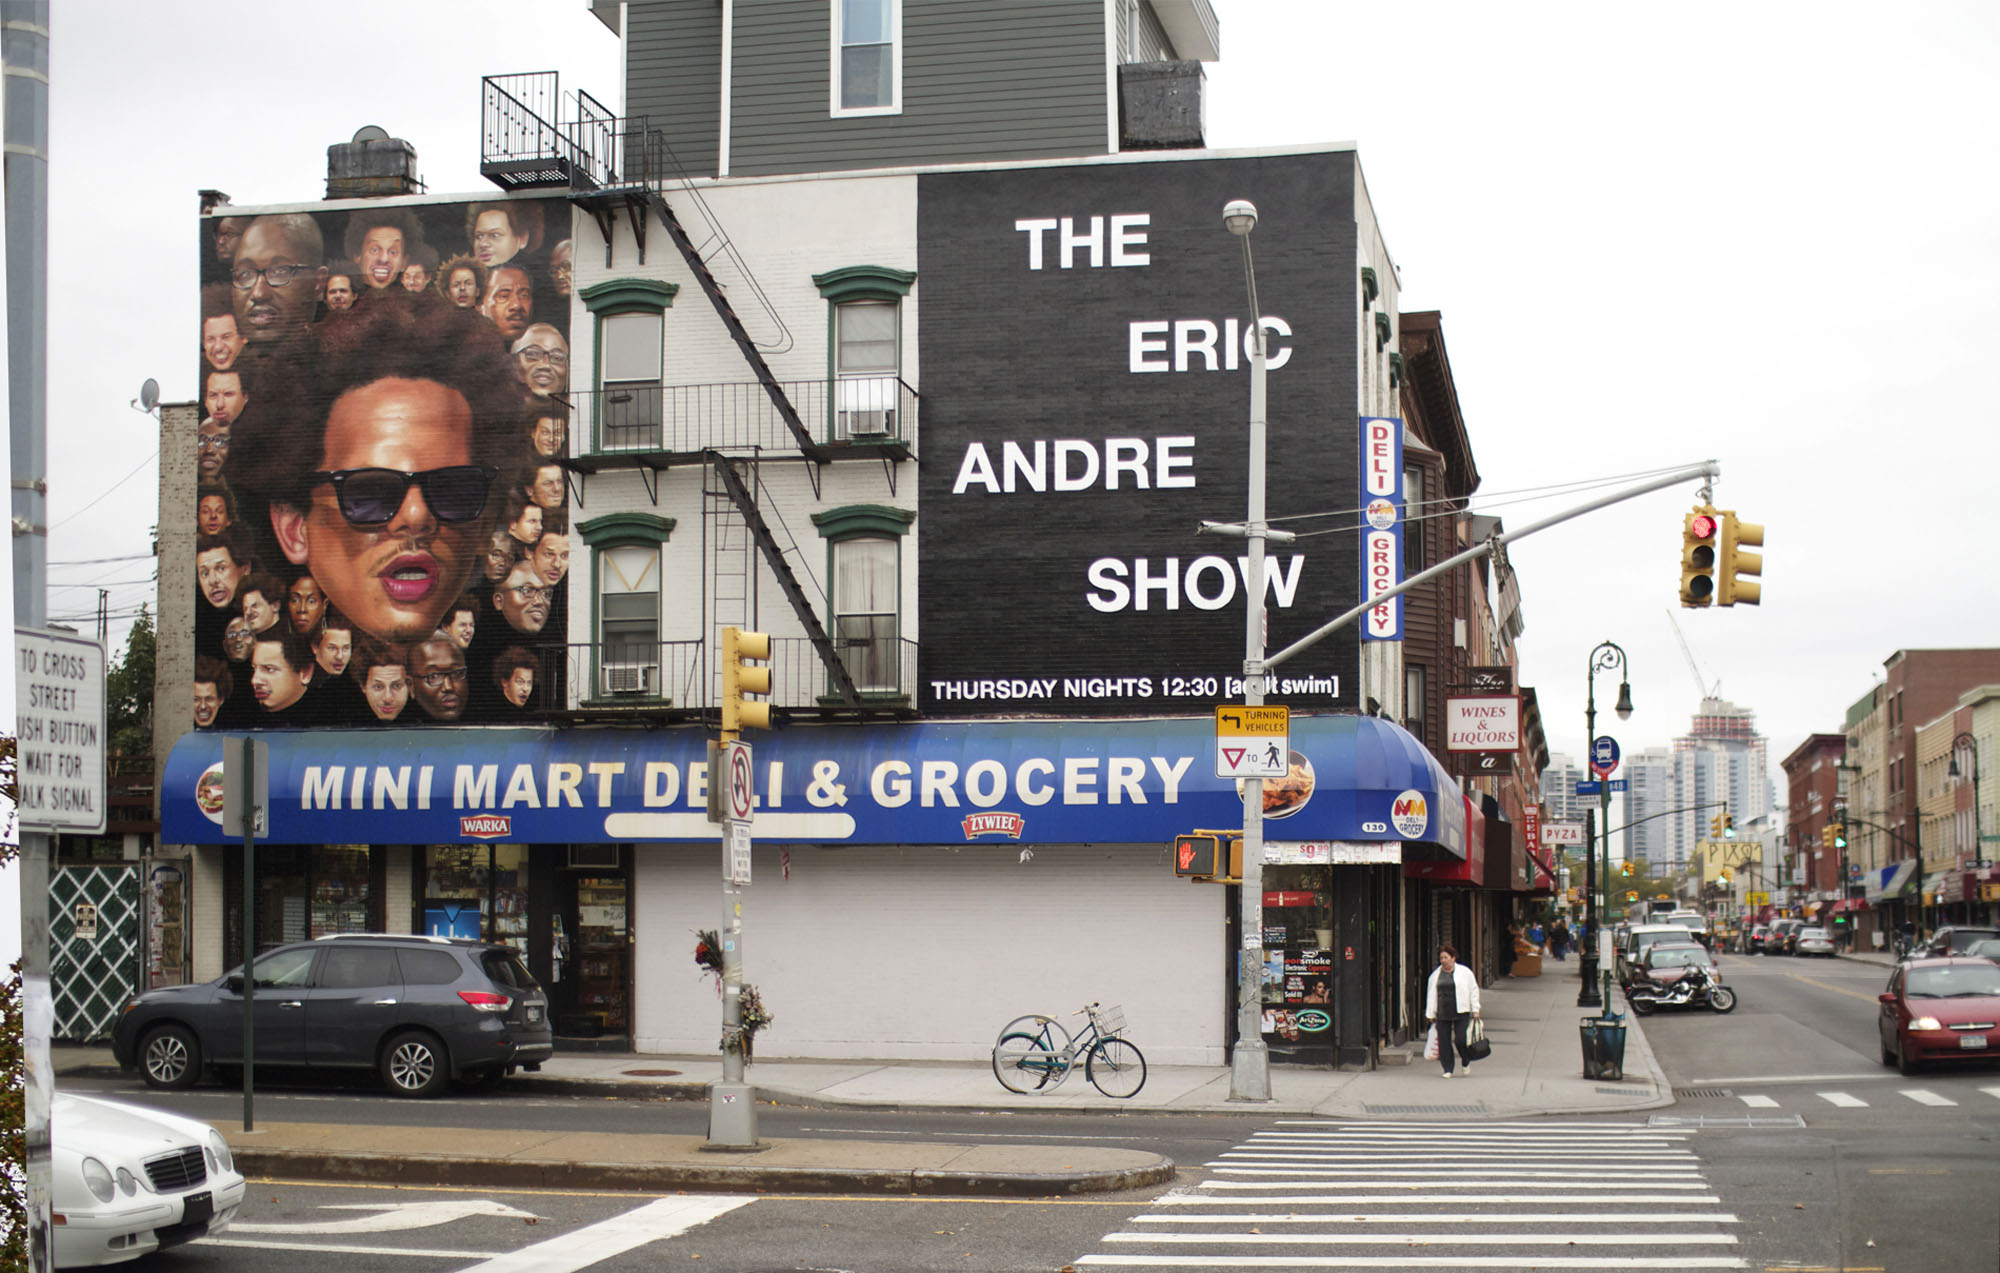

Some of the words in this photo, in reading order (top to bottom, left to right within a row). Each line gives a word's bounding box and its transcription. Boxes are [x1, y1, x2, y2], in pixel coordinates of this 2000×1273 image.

[1015, 213, 1150, 270] THE
[1129, 316, 1292, 373] ERIC
[952, 436, 1196, 494] ANDRE
[1372, 426, 1388, 489] DELI
[1086, 555, 1304, 613] SHOW
[20, 649, 36, 673] TO
[43, 652, 86, 681] CROSS
[30, 683, 76, 712] STREET
[931, 680, 1056, 700] THURSDAY
[1063, 678, 1153, 698] NIGHTS
[1161, 677, 1218, 697] 12:30
[1281, 675, 1340, 698] swim]
[1245, 711, 1285, 720] TURNING
[1461, 707, 1506, 718] WINES
[1477, 720, 1488, 730] &
[16, 716, 43, 741] USH
[50, 719, 97, 746] BUTTON
[1245, 723, 1285, 732] VEHICLES
[1452, 732, 1516, 745] LIQUORS
[25, 752, 52, 776] WAIT
[58, 752, 82, 778] FOR
[1247, 754, 1258, 763] TO
[301, 765, 434, 810] MINI
[453, 762, 625, 809] MART
[643, 761, 784, 807] DEI
[806, 760, 849, 807] &
[870, 757, 1195, 808] GROCERY
[51, 786, 94, 812] SIGNAL
[464, 820, 508, 832] WARKA
[1546, 829, 1577, 839] PYZA
